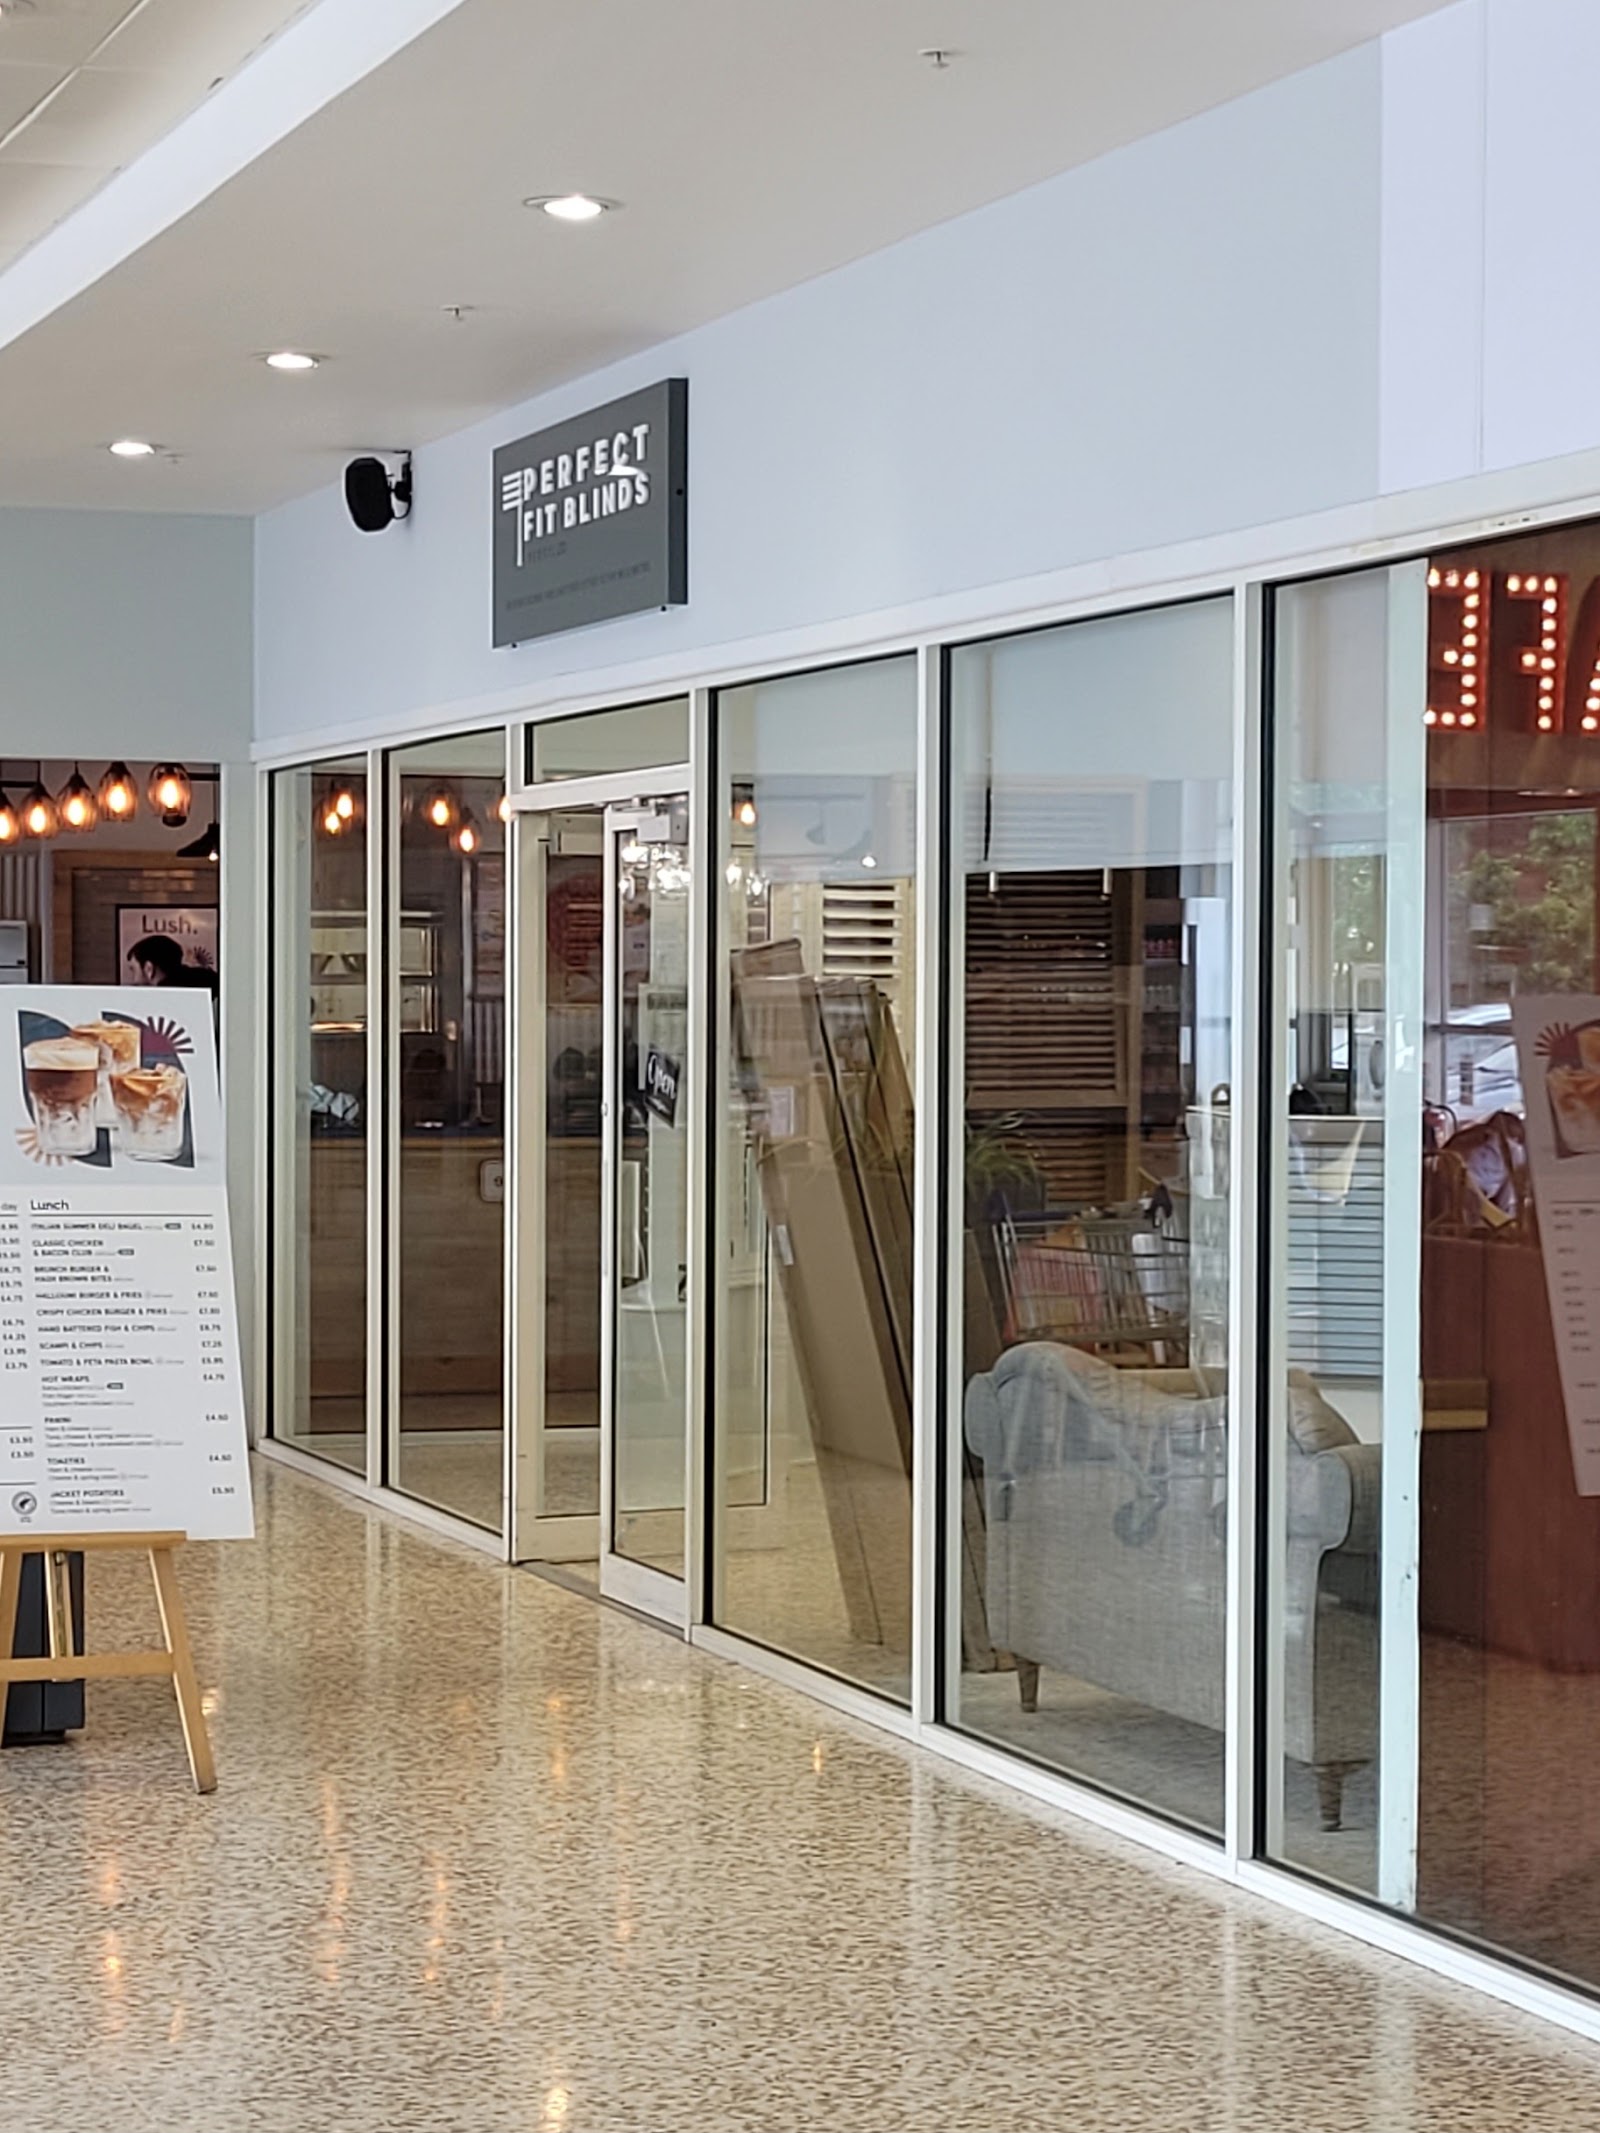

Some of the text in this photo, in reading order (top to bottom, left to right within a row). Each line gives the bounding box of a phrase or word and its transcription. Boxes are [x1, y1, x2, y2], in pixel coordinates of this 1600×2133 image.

[523, 424, 650, 501] PERFECT
[523, 473, 650, 542] FIT BLINDS
[142, 914, 198, 935] Lush.
[30, 1200, 70, 1212] Lunch
[70, 1266, 101, 1274] BURGER
